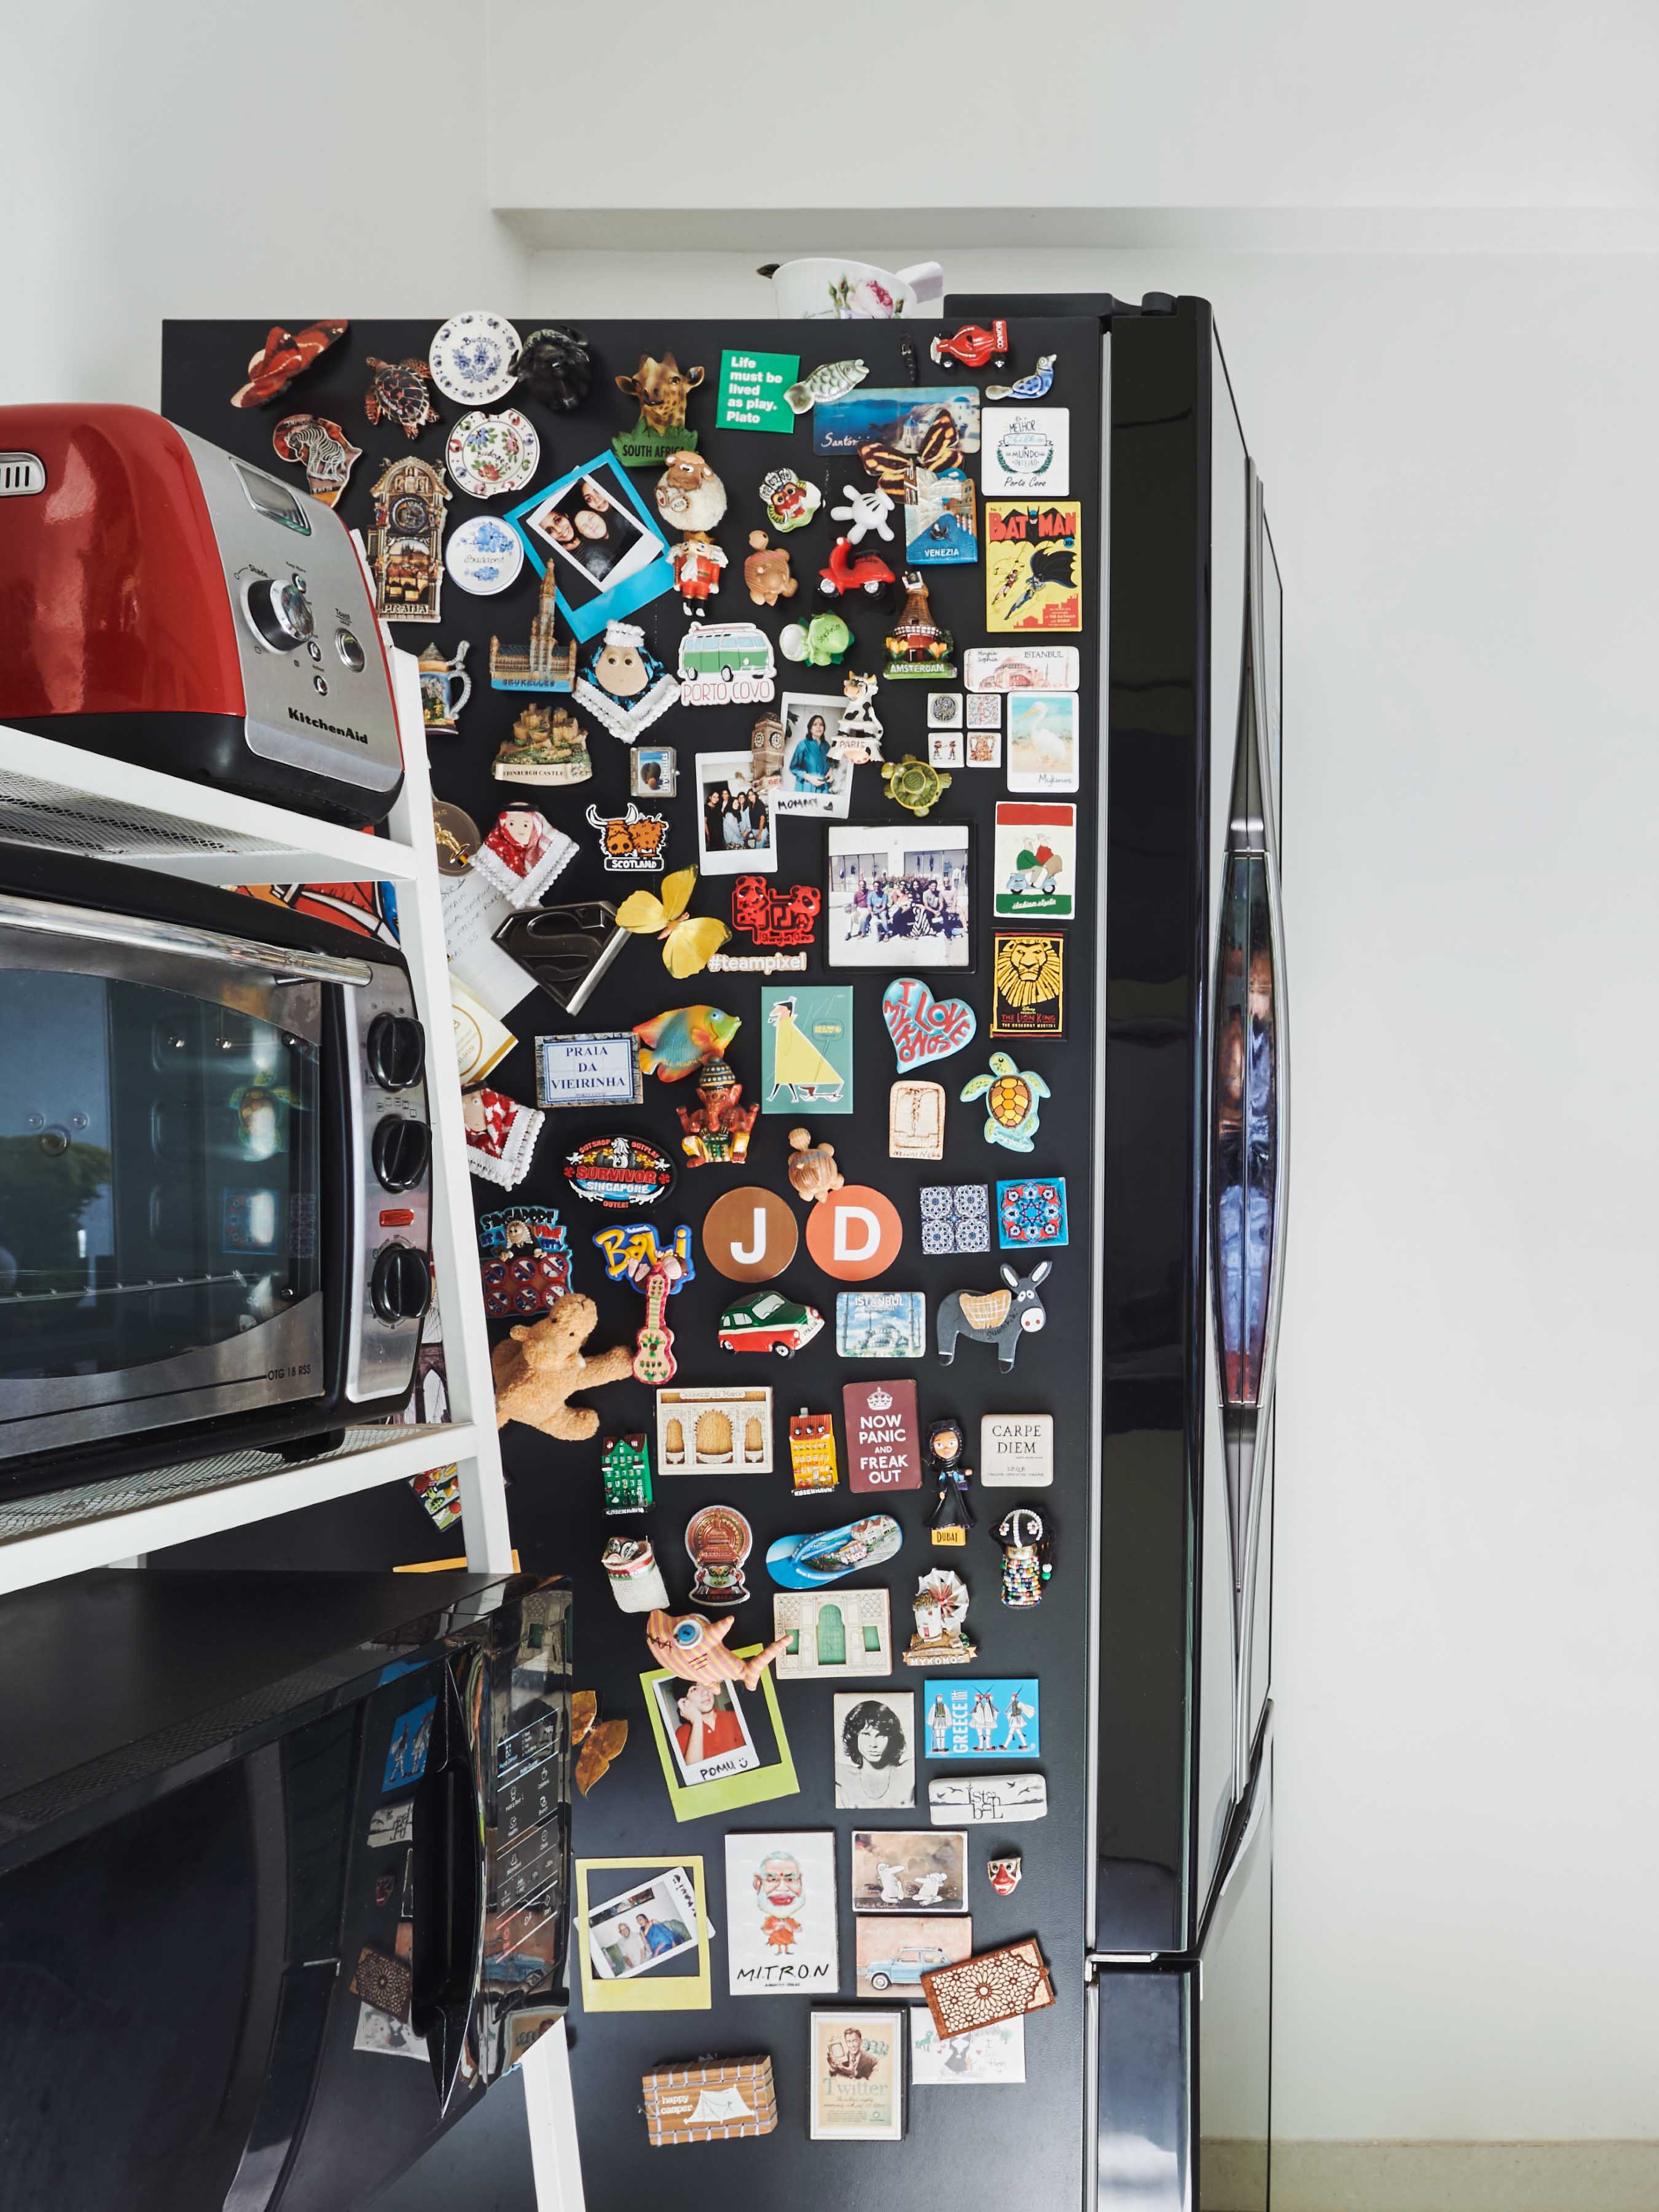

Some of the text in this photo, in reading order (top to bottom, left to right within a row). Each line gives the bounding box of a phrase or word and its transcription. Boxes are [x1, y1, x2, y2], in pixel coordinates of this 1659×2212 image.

[995, 321, 1004, 349] MONACO
[731, 356, 756, 369] Life
[730, 371, 783, 383] must be
[729, 383, 760, 396] lived
[728, 398, 777, 411] as play.
[726, 410, 760, 424] Plato
[1010, 420, 1035, 433] MELHOR
[622, 444, 651, 457] SOUTH
[1012, 450, 1038, 458] MUNDO
[1004, 476, 1046, 487] Porto Covo
[249, 563, 268, 578] Shade
[890, 664, 945, 673] AMSTERDAM
[683, 681, 771, 702] PORTO COVO
[288, 707, 368, 745] KitchenAid
[611, 859, 658, 870] SCOTLAND
[709, 953, 805, 974] #teampixel
[898, 981, 971, 1046] I LOVE
[1017, 1013, 1034, 1022] LION
[1037, 1013, 1056, 1022] KING
[566, 1046, 608, 1057] PRAIA
[578, 1062, 597, 1072] DA
[551, 1077, 626, 1090] VIEIRINHA
[631, 1141, 661, 1159] OUTPLAY
[576, 1165, 657, 1185] SURVIVOR
[586, 1181, 650, 1194] SINGAPORE
[731, 1207, 766, 1265] J
[834, 1206, 881, 1261] D
[855, 1296, 904, 1306] ISTANBUL
[268, 1364, 311, 1380] OTG 18 RSS
[860, 1414, 902, 1429] NOW
[859, 1429, 906, 1444] PANIC
[992, 1426, 1042, 1437] CARPE
[874, 1445, 892, 1454] AND
[998, 1442, 1036, 1454] DIEM
[860, 1454, 909, 1470] FREAK
[868, 1470, 901, 1484] OUT
[936, 1532, 959, 1543] DUBAI
[911, 1655, 964, 1666] MYKONOS
[952, 1703, 969, 1754] GREECE
[823, 2077, 888, 2096] Twitter
[662, 2095, 689, 2104] happy
